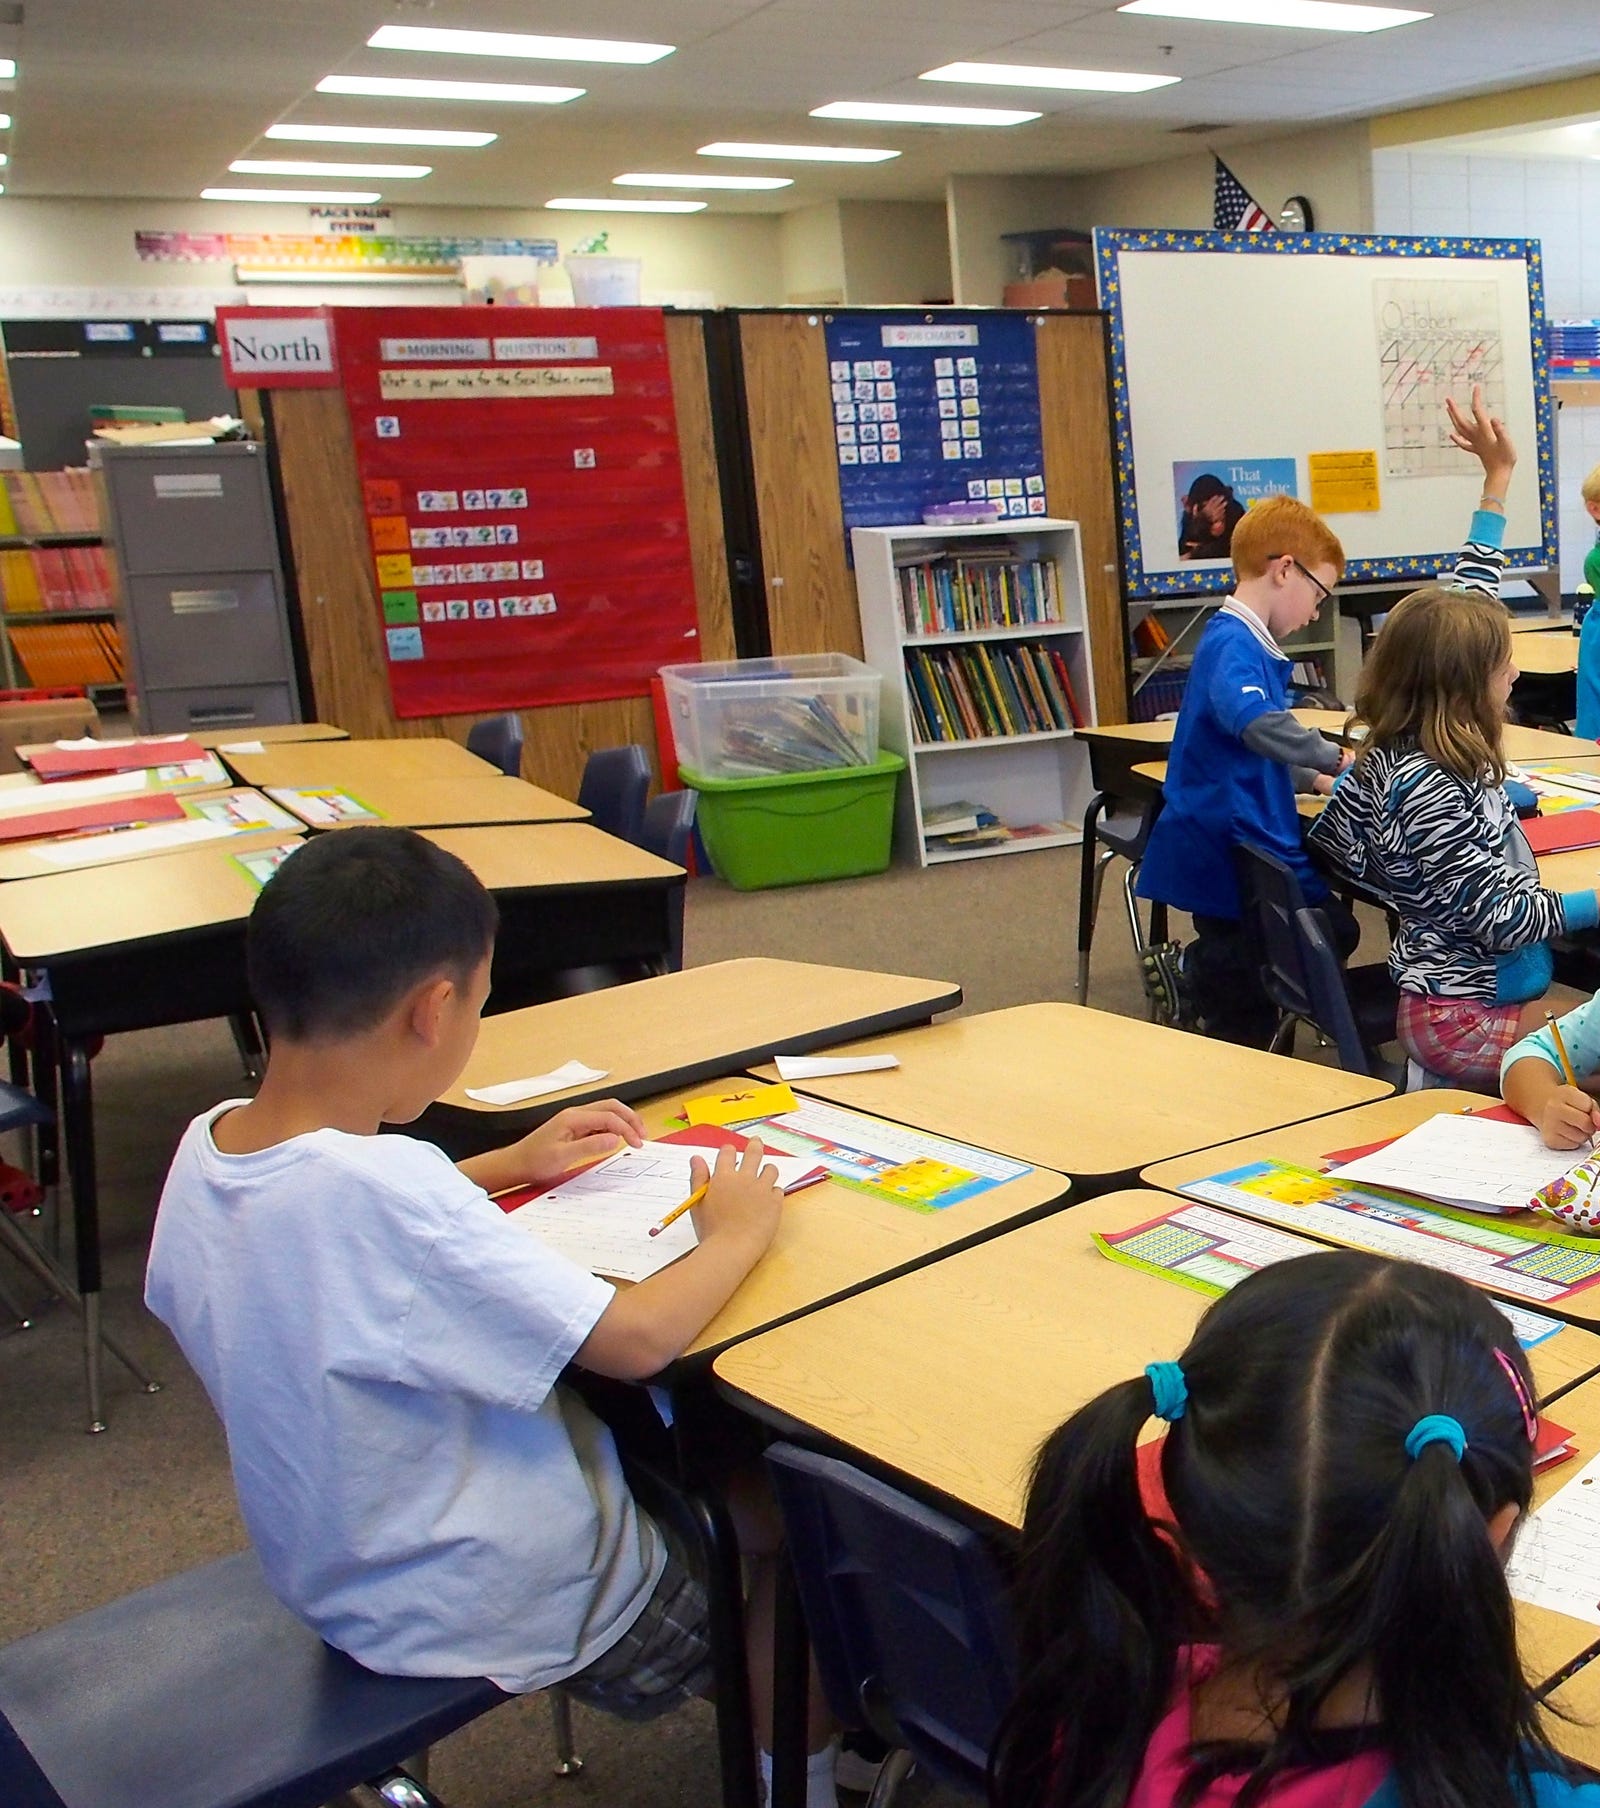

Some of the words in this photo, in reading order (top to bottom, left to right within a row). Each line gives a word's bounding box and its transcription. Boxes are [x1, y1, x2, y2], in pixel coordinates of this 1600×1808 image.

[1382, 300, 1457, 329] October
[231, 336, 321, 362] North
[407, 343, 475, 356] MORNING
[499, 342, 566, 355] QUESTION
[1228, 466, 1262, 482] That
[1237, 484, 1262, 496] was
